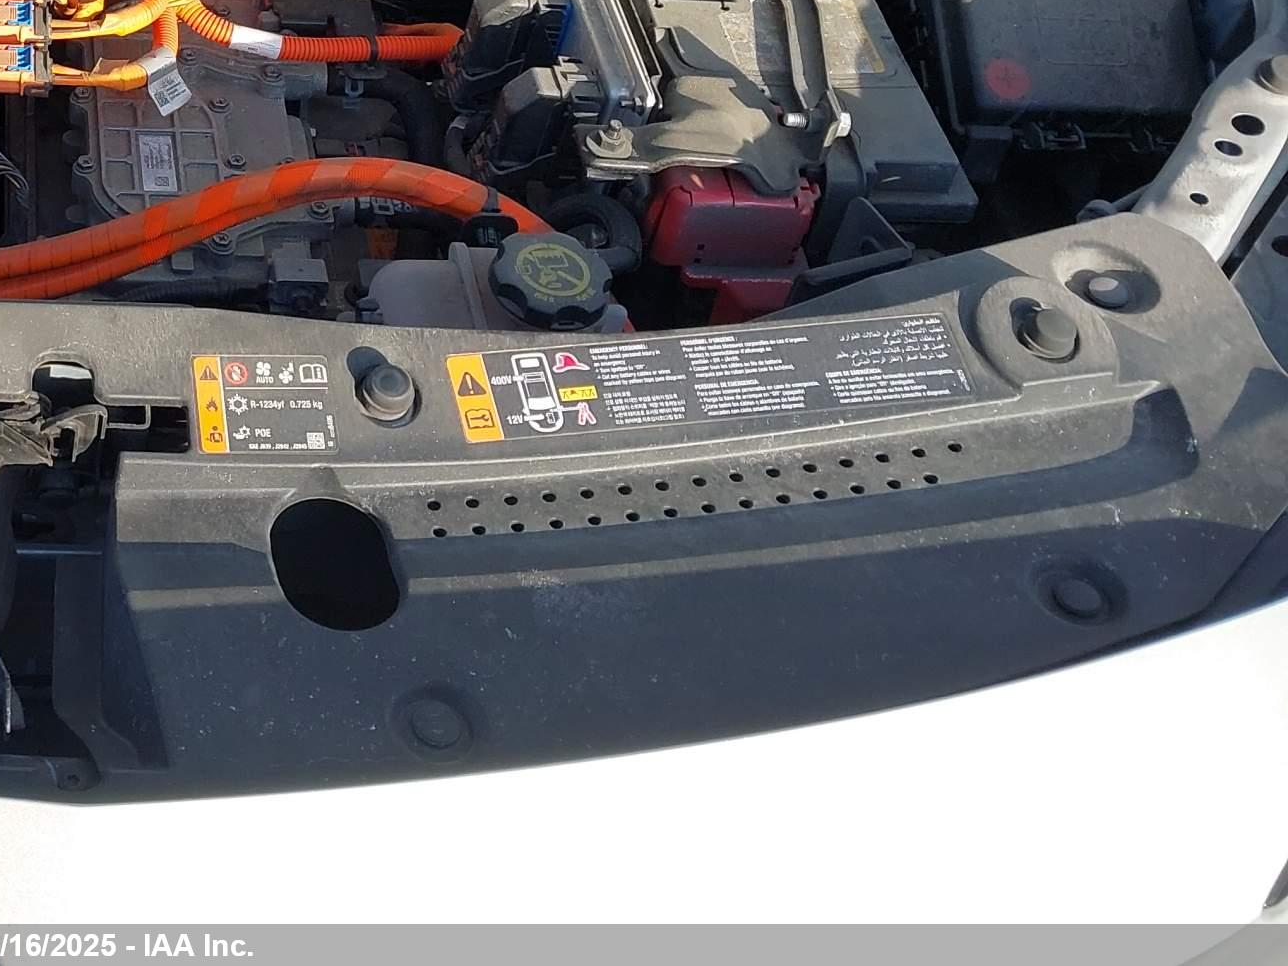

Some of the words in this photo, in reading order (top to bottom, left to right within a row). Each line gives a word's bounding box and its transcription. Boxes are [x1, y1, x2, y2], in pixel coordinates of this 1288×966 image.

[491, 375, 512, 386] 400V
[250, 400, 284, 410] R-1234yf
[290, 400, 311, 408] 0.725
[313, 400, 323, 410] kg
[506, 414, 523, 425] 12V
[255, 428, 271, 437] POE
